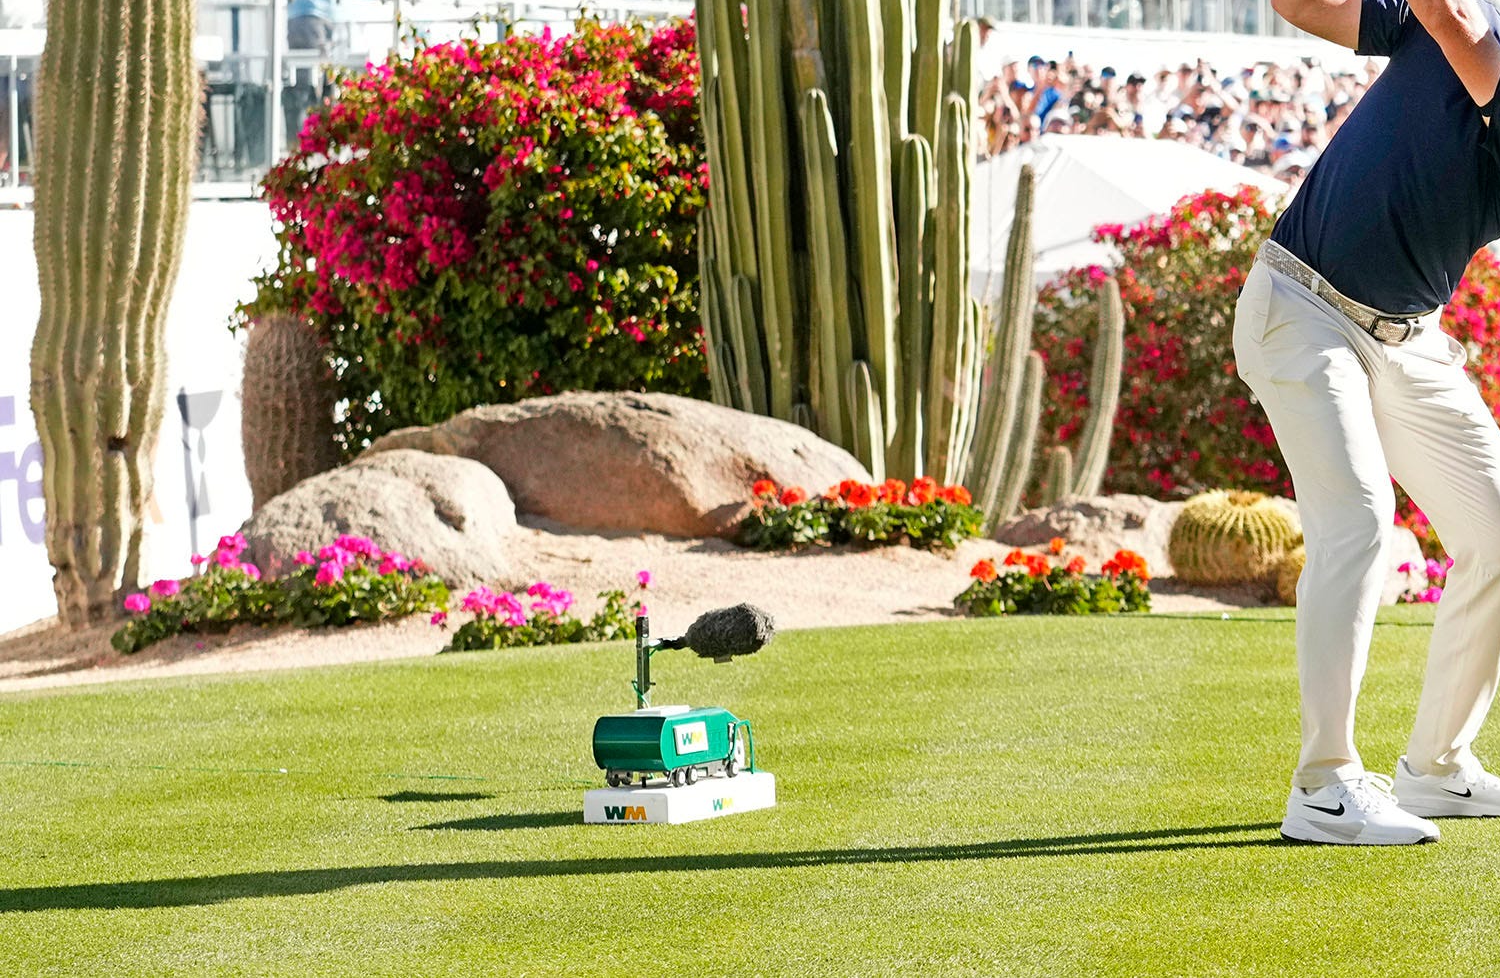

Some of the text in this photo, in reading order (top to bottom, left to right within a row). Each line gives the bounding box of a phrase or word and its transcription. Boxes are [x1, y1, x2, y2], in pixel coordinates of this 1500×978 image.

[681, 730, 704, 746] WM
[713, 797, 734, 812] WM
[604, 806, 648, 821] WM
